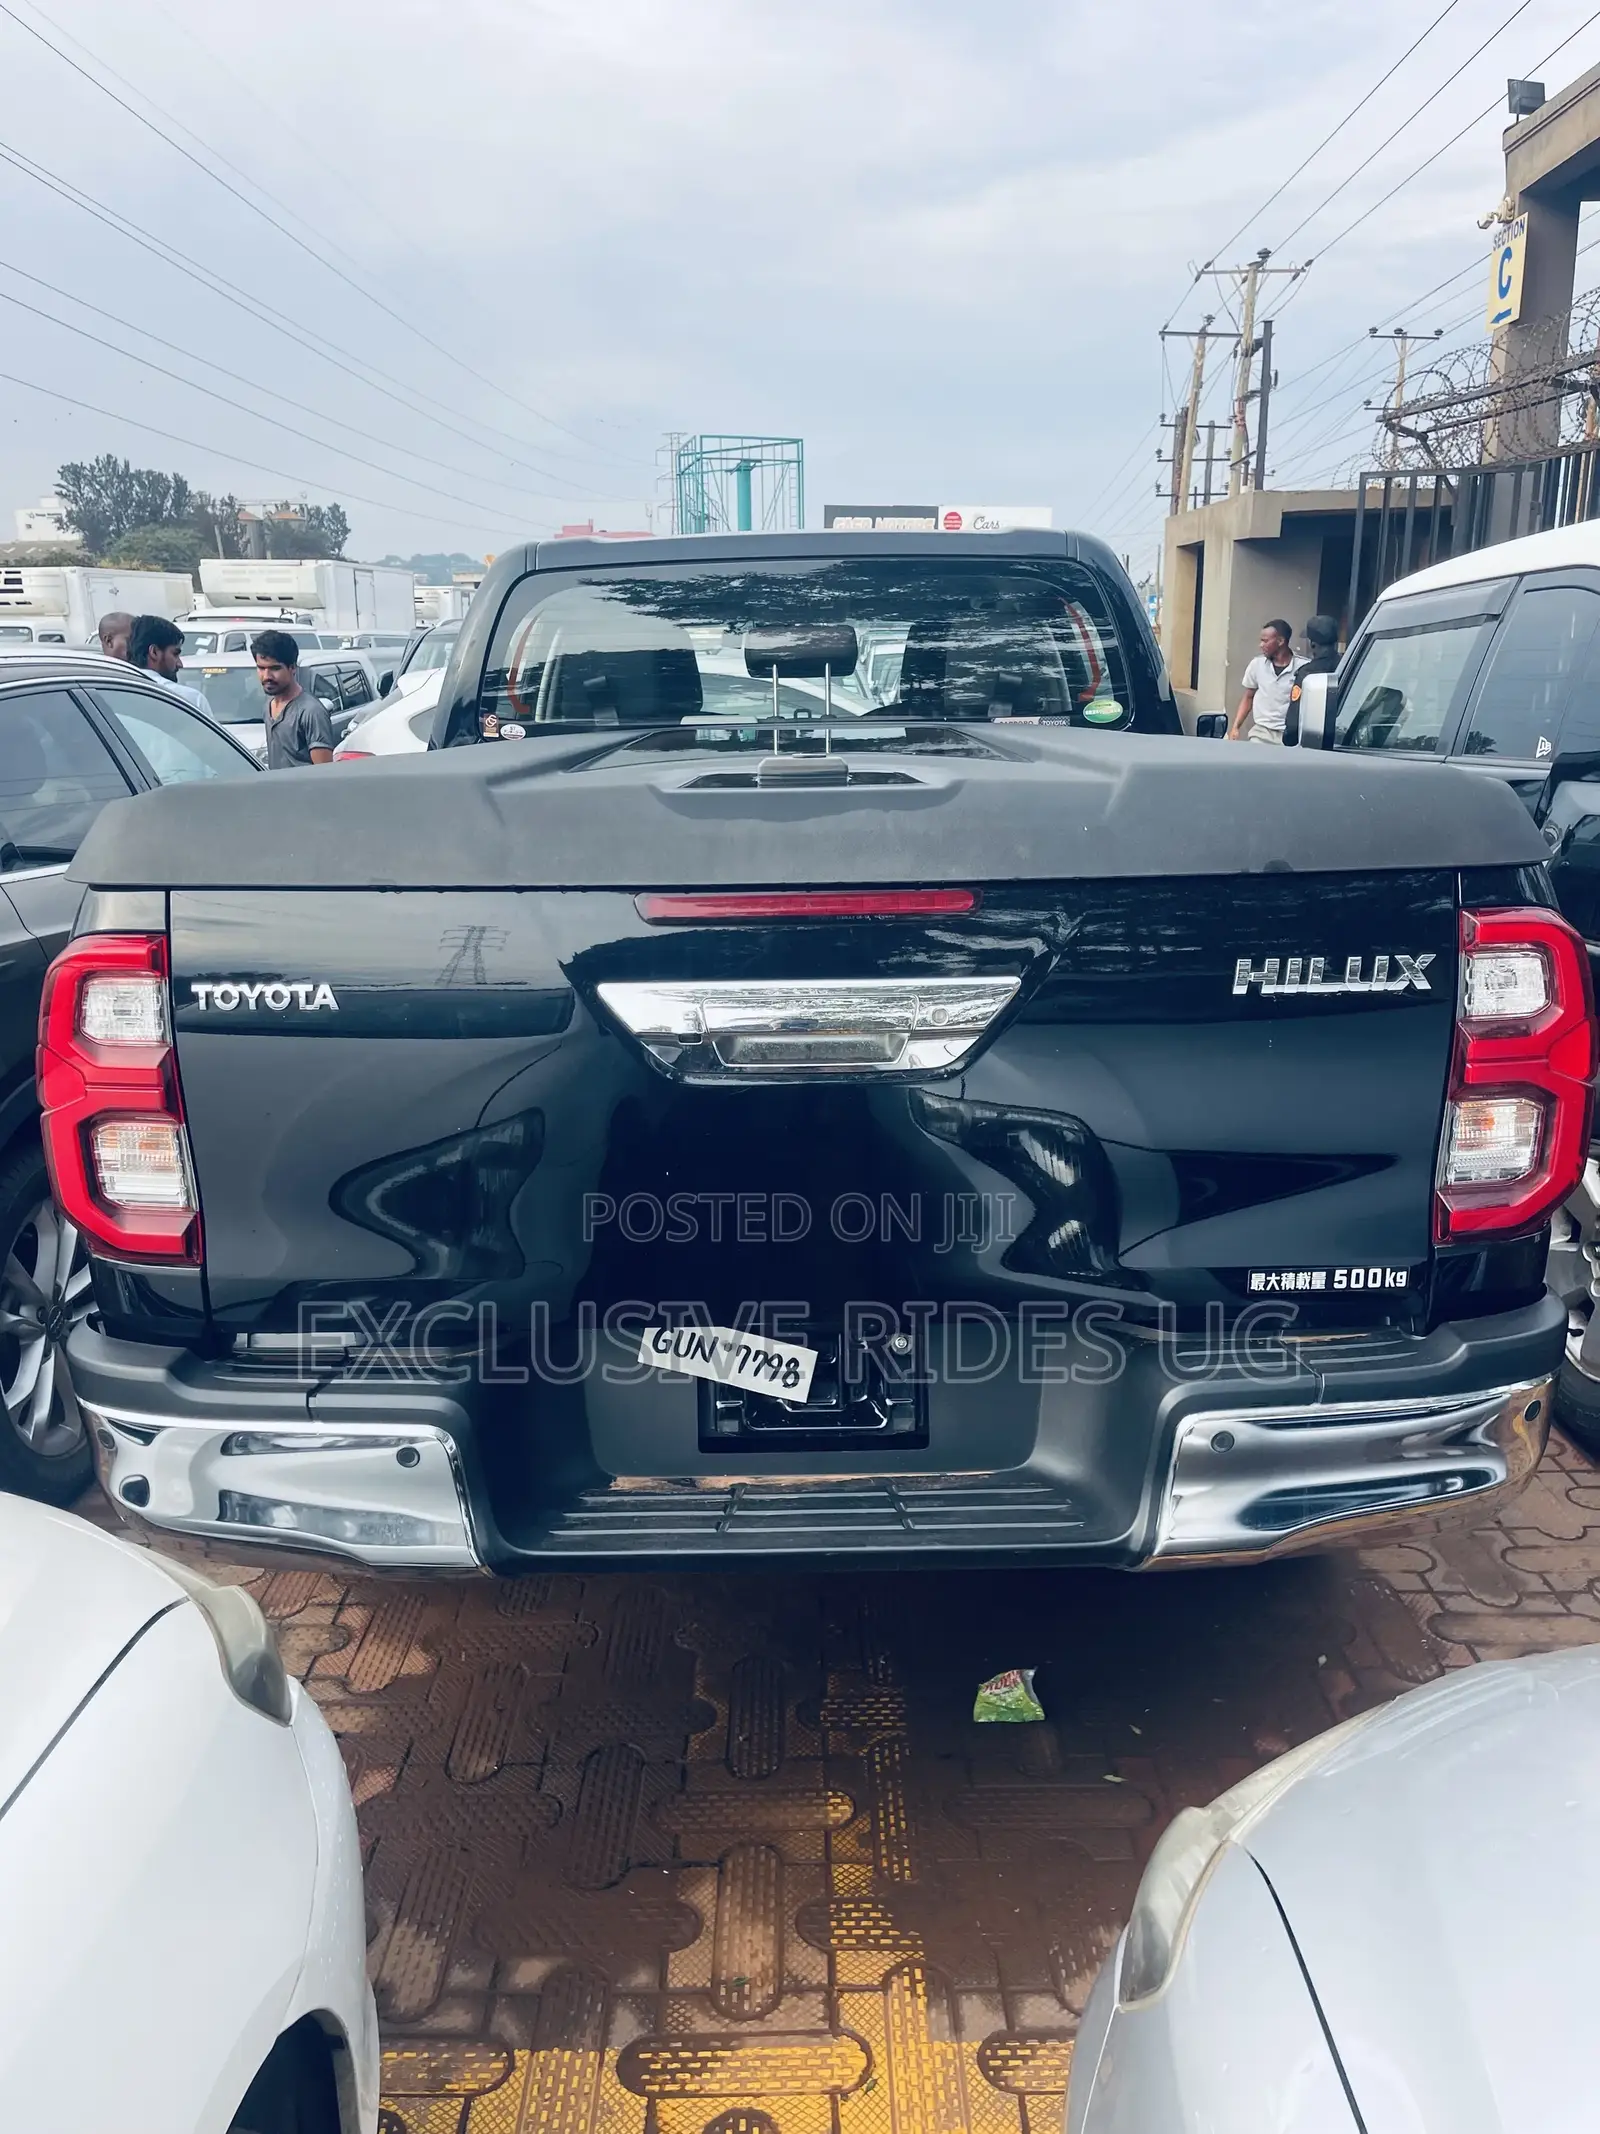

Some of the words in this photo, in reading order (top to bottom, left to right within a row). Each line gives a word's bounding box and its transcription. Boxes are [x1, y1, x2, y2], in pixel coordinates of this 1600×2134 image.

[1493, 216, 1525, 251] SECTION
[1498, 246, 1512, 299] C
[973, 516, 1000, 530] Cars
[1232, 953, 1436, 995] HILUX
[190, 982, 340, 1011] TOYOTA
[1250, 1271, 1327, 1291] 最大積載量
[1333, 1268, 1408, 1290] 500kg
[652, 1326, 719, 1363] GUN
